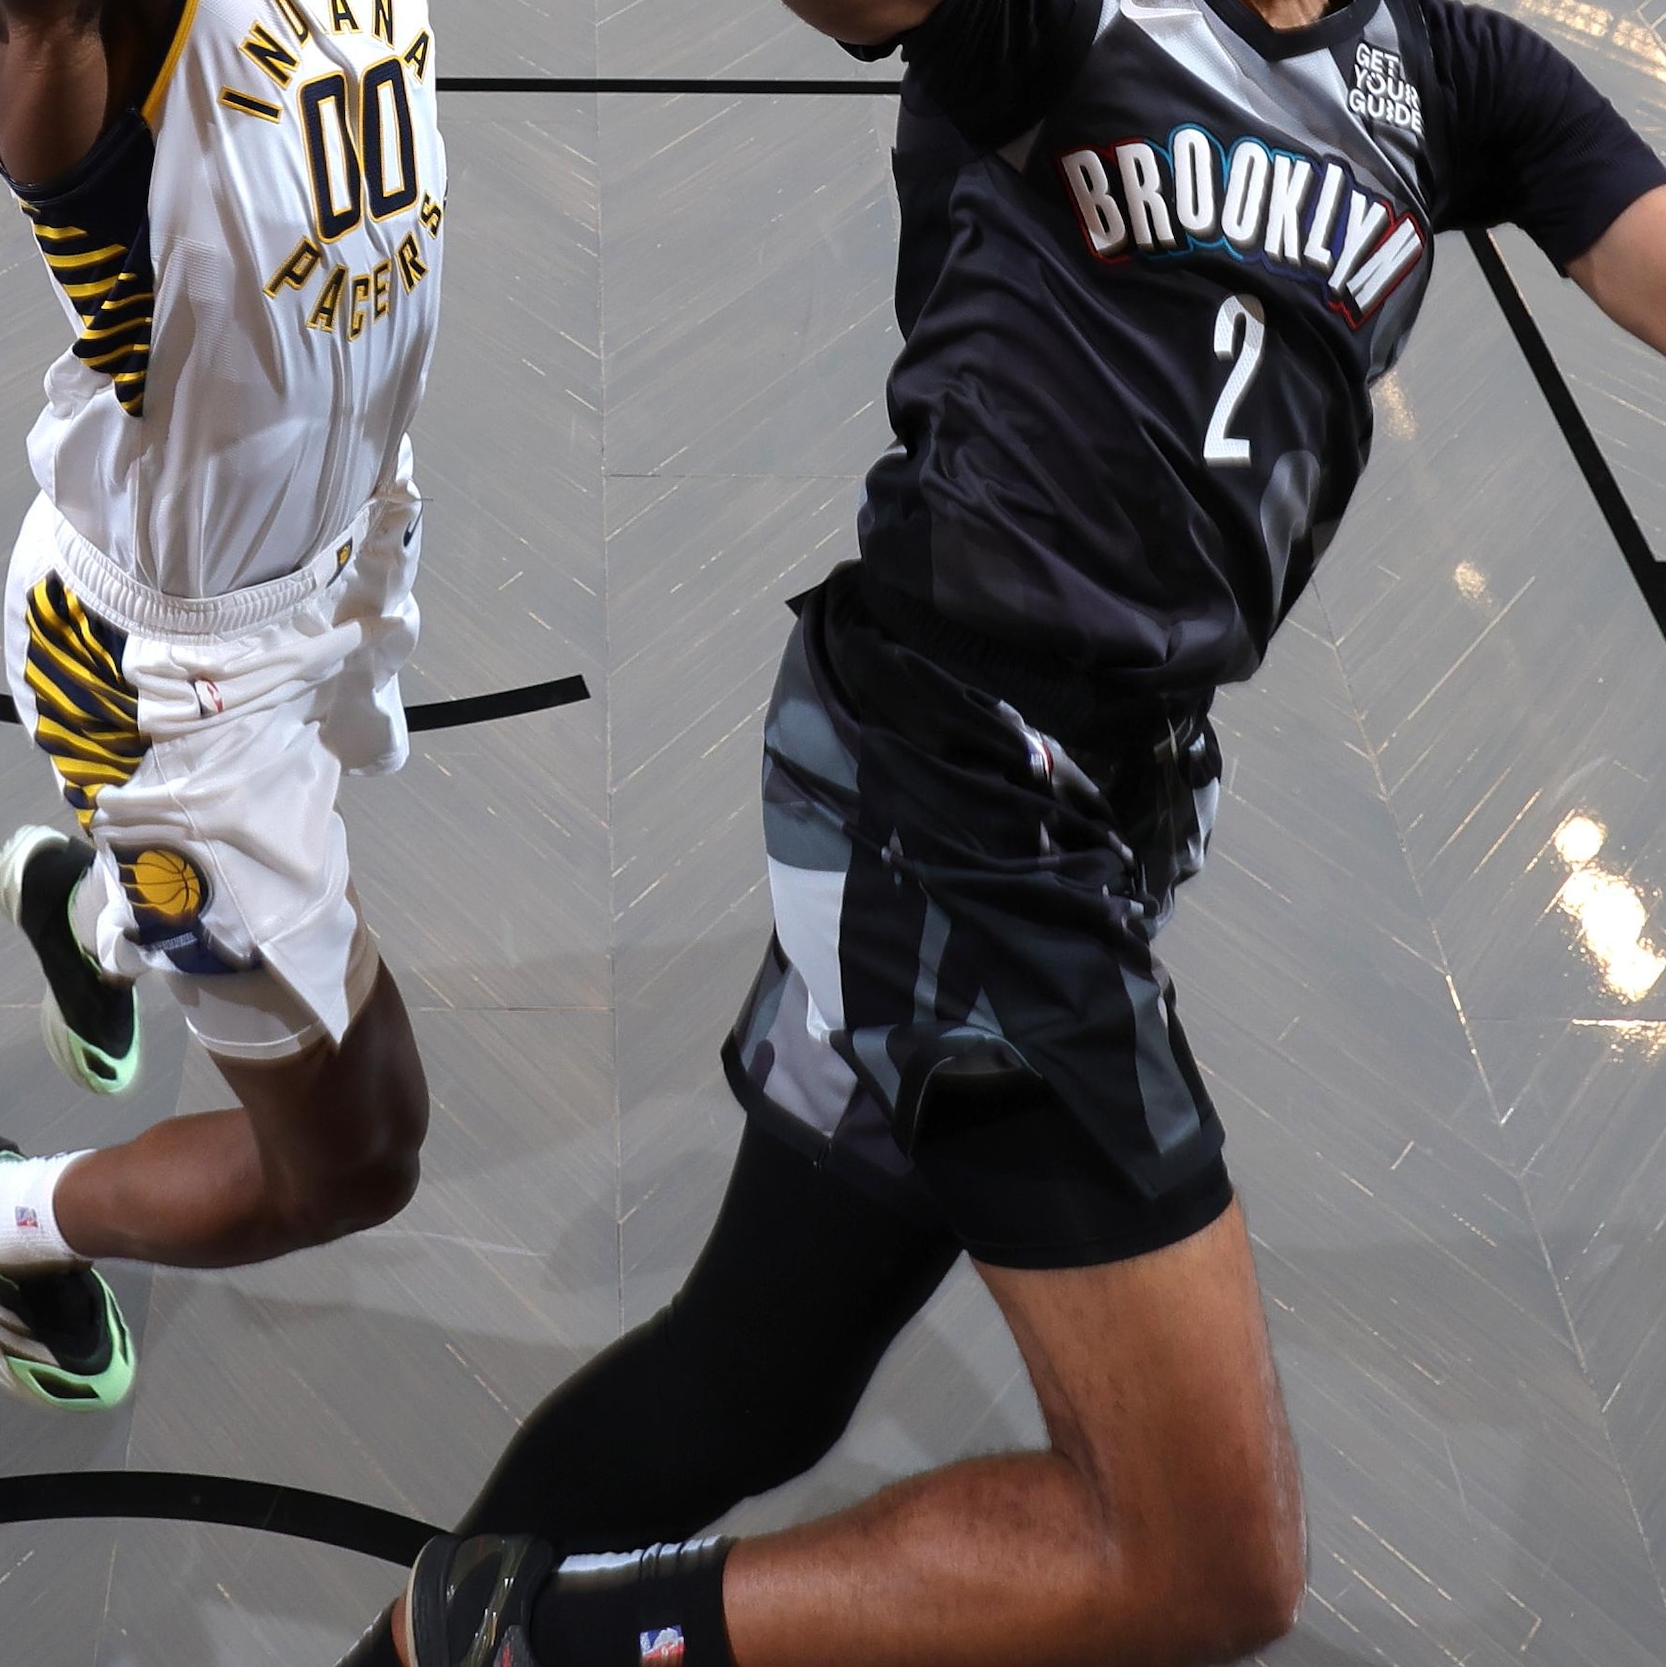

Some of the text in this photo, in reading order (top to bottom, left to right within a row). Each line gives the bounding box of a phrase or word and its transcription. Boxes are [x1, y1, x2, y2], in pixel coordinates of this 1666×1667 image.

[1349, 88, 1424, 135] GUIDE
[1354, 63, 1421, 112] YOUR
[1356, 42, 1400, 77] GET
[299, 55, 419, 244] 00
[1061, 126, 1426, 313] BROOKLYN
[263, 188, 442, 342] PACERS
[1202, 294, 1266, 467] 2
